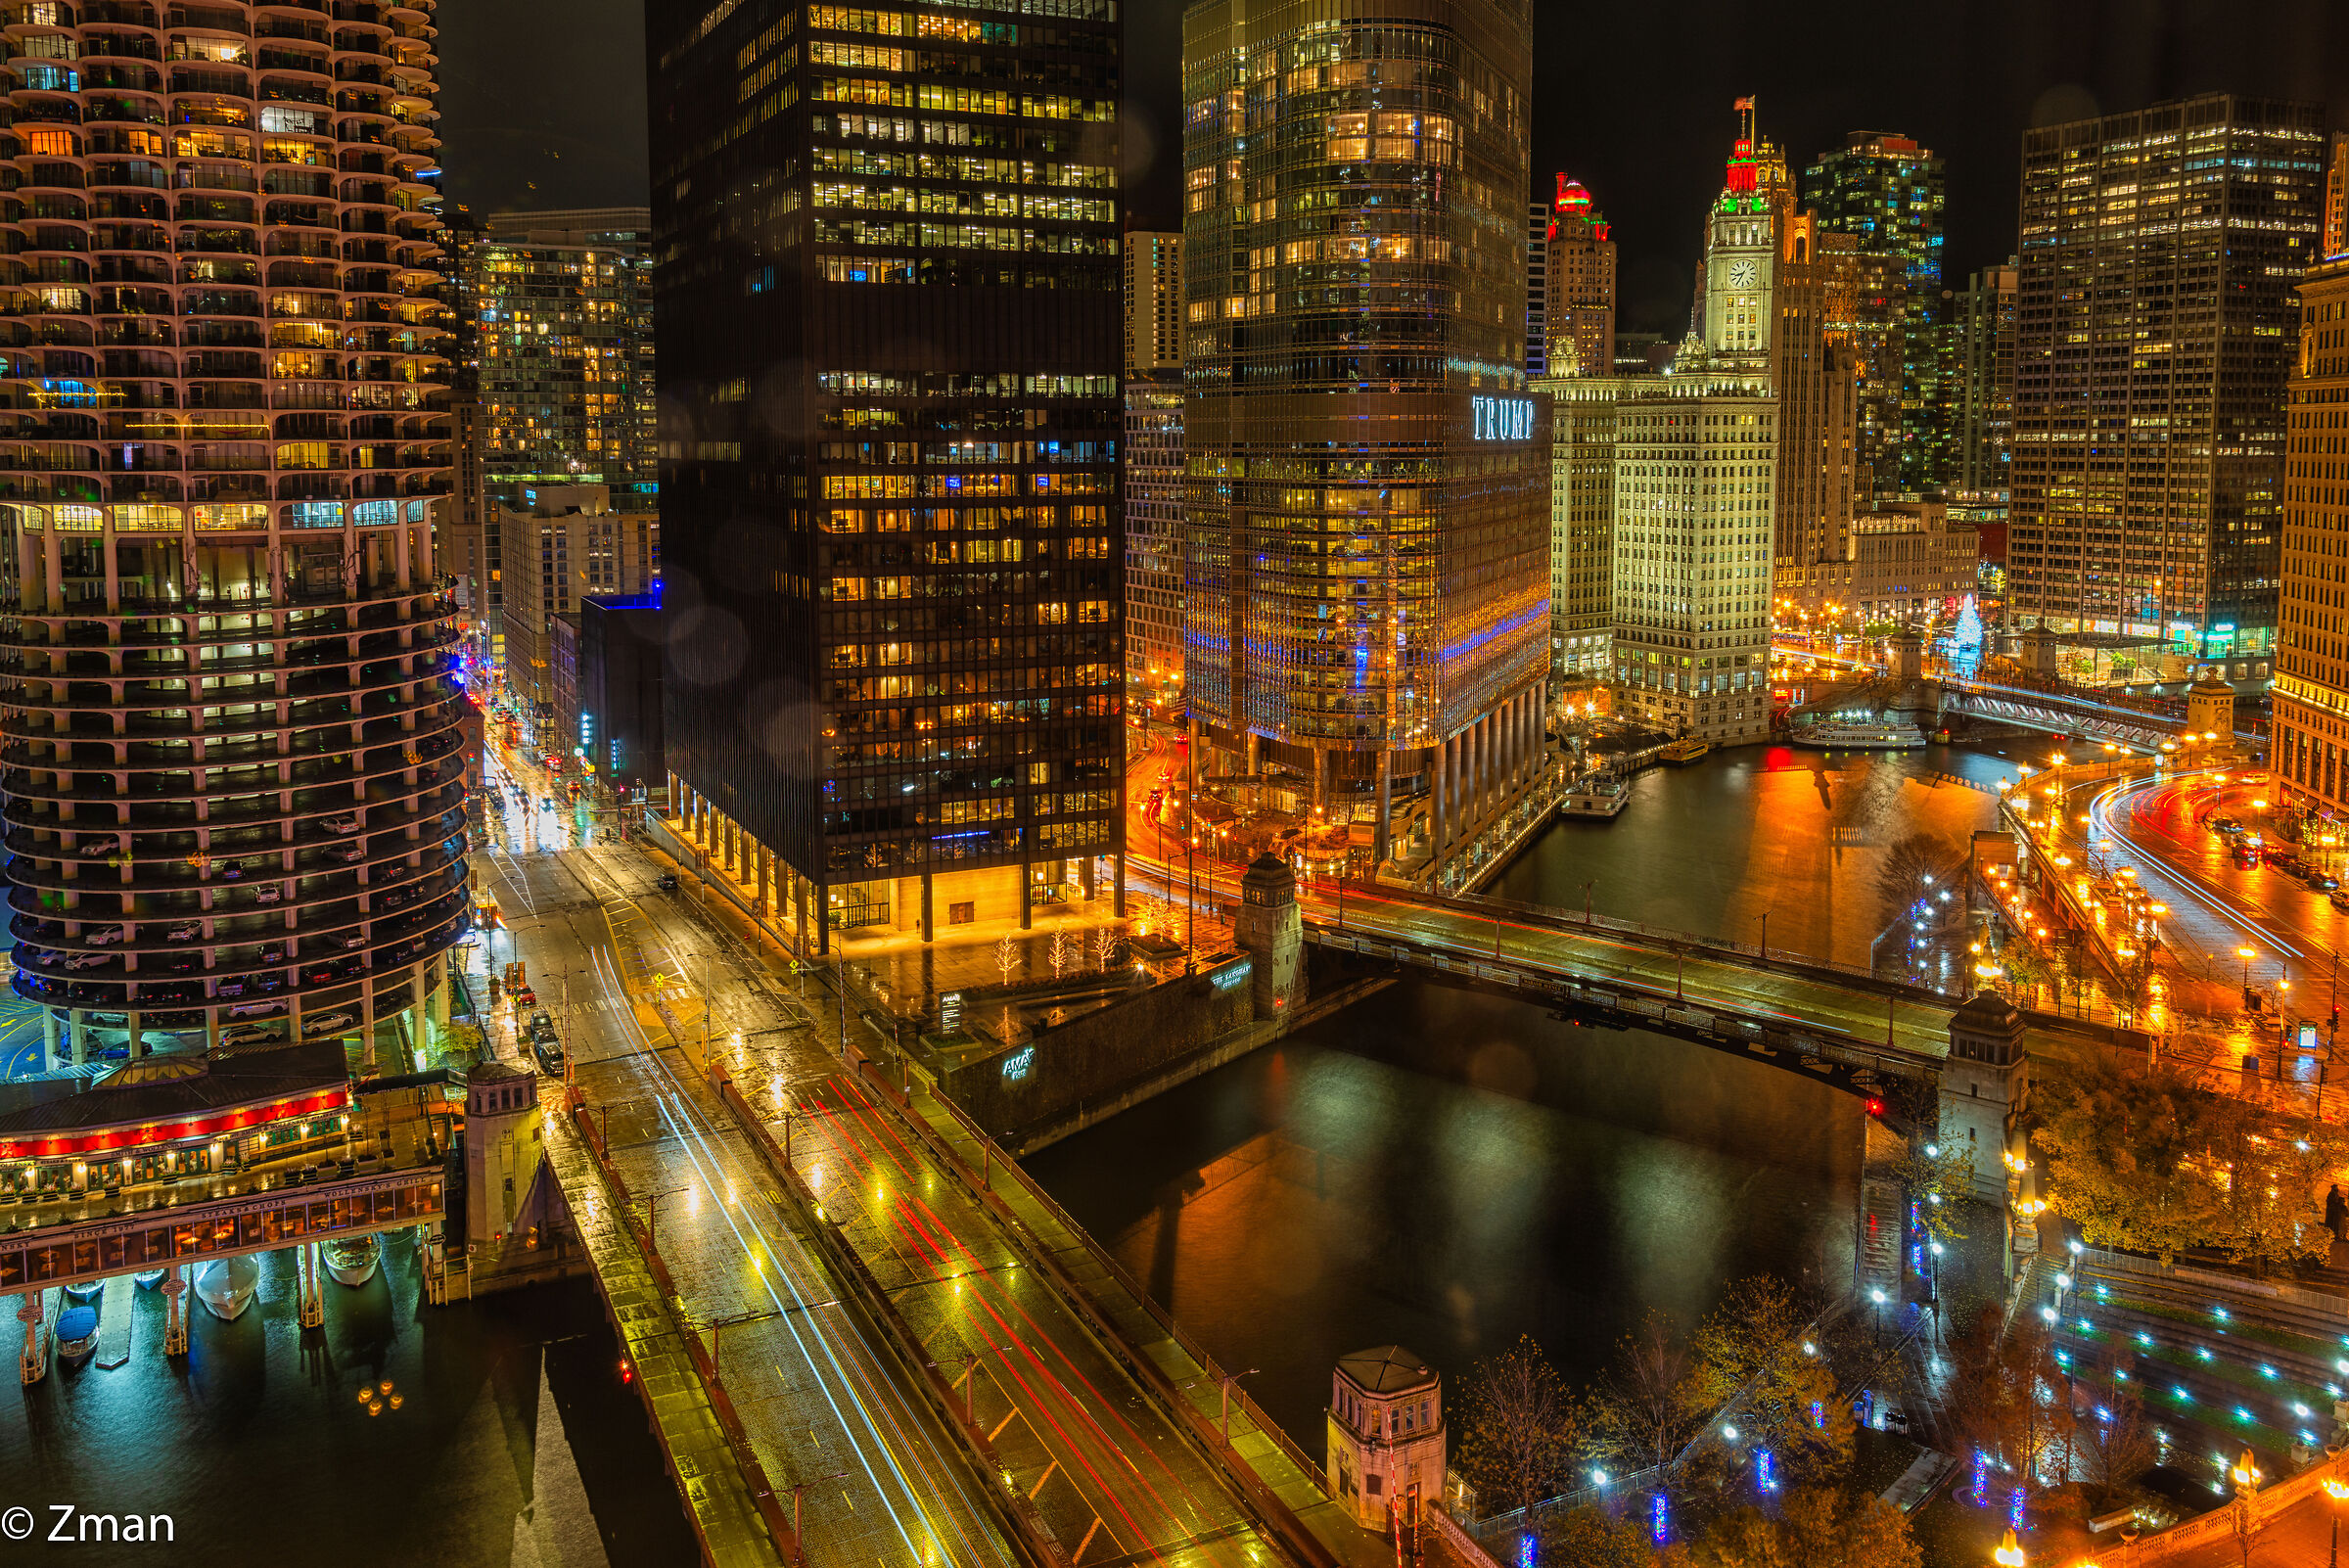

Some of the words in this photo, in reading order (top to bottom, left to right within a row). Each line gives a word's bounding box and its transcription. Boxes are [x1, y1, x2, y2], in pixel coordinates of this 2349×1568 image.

[1472, 395, 1535, 440] TRUMP
[396, 1176, 427, 1187] GRILL
[73, 1228, 109, 1239] SINCE
[113, 1223, 135, 1233] 1977
